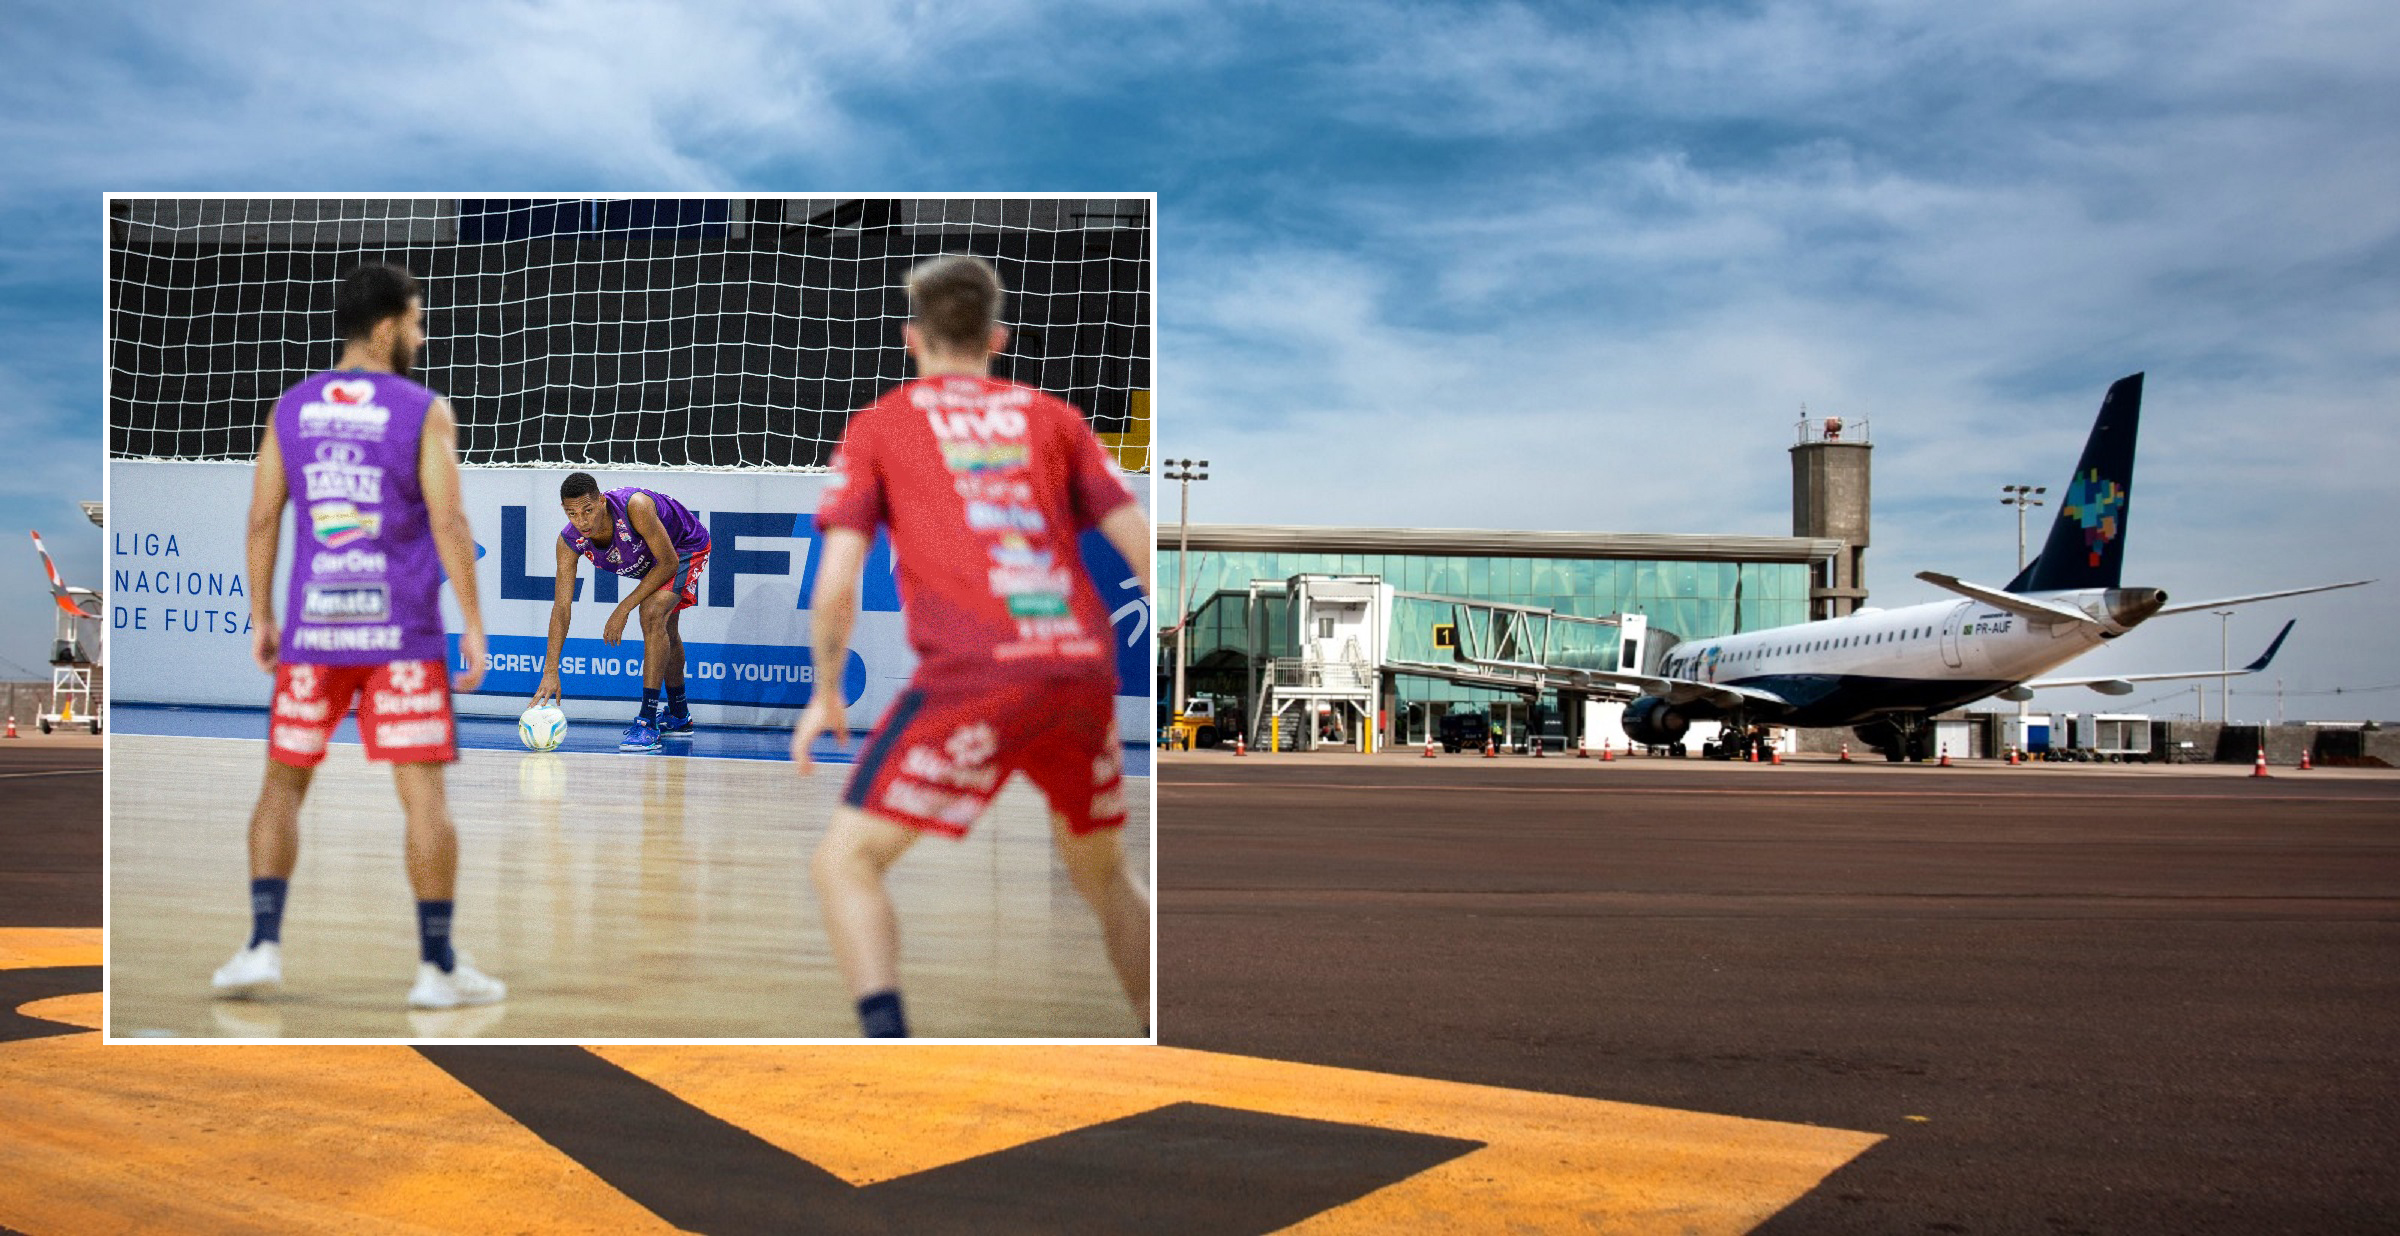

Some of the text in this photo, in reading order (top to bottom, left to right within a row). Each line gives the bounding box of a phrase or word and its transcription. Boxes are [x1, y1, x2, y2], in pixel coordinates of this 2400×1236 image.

[116, 532, 180, 557] LIGA
[115, 569, 244, 597] NACIONA
[114, 606, 253, 635] DE FUTSA
[1975, 620, 2012, 635] PR-AUF
[1442, 629, 1450, 644] 1
[460, 652, 586, 675] ISCREV-SE
[591, 657, 621, 676] NO
[698, 661, 727, 680] DO
